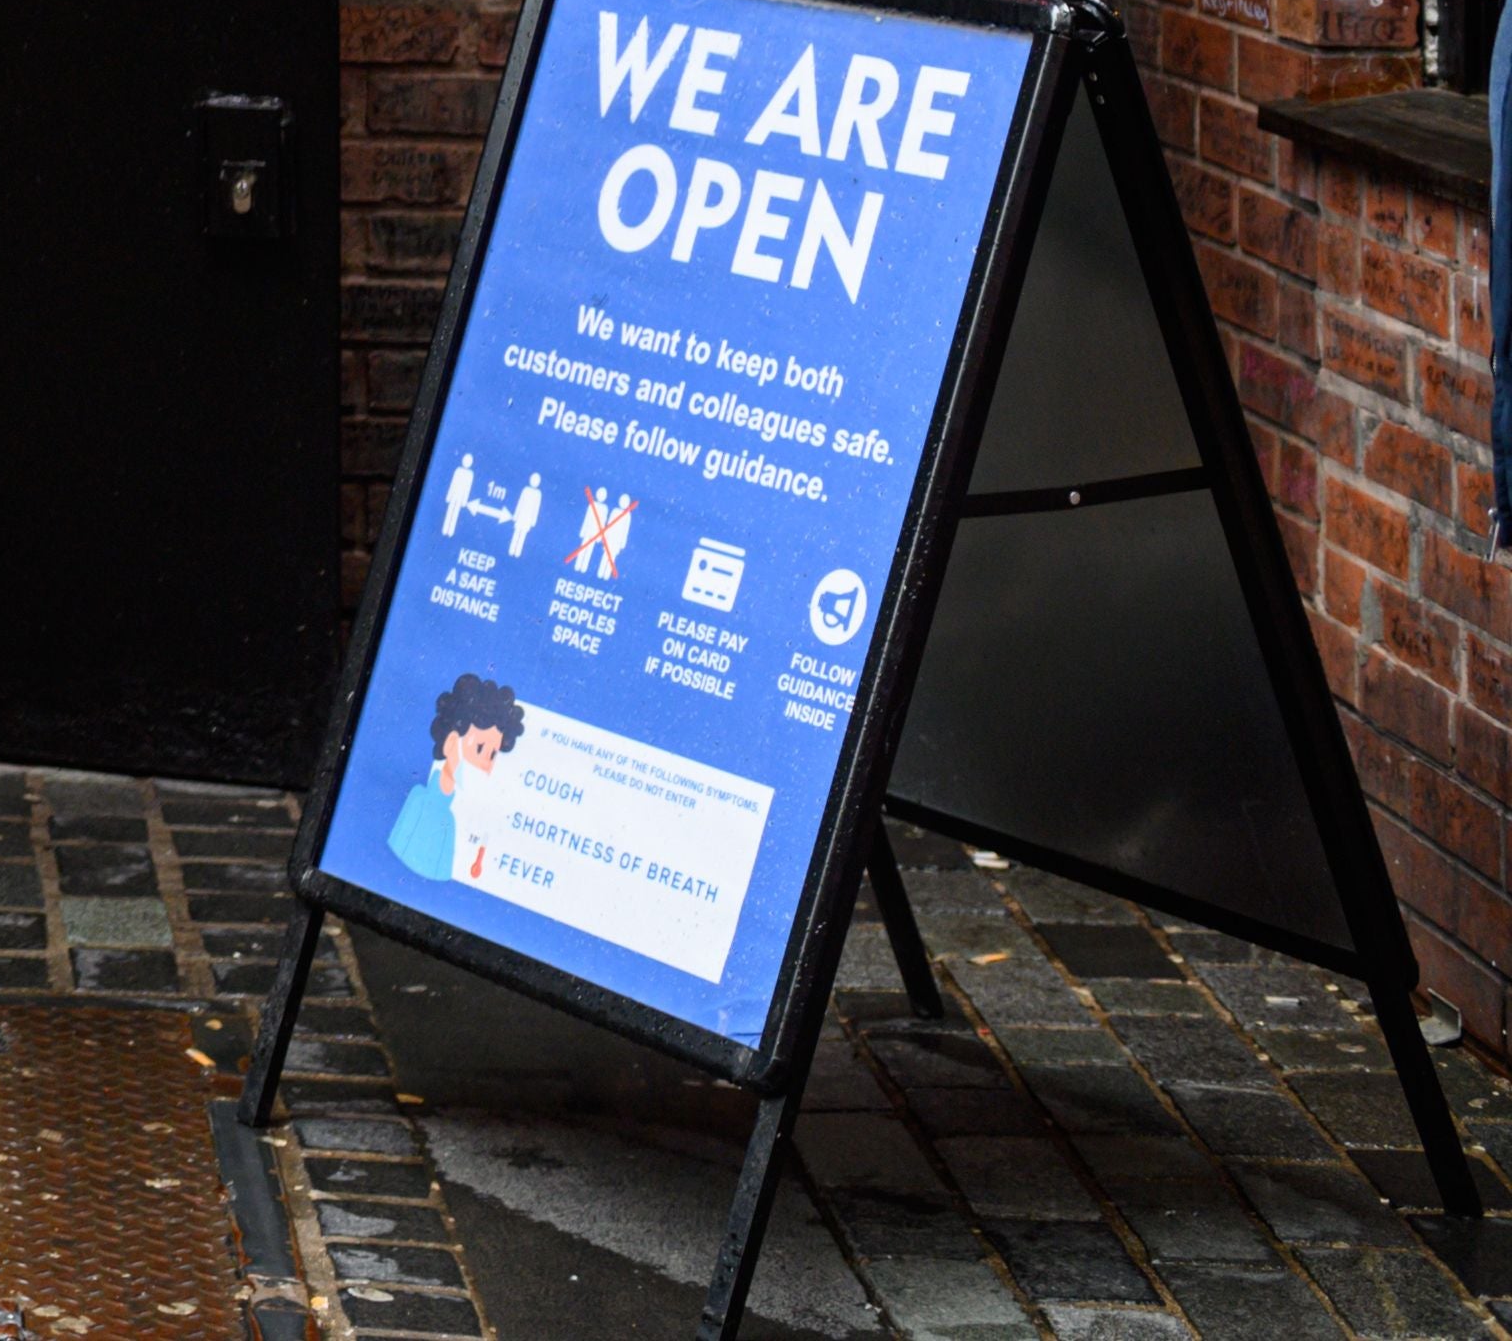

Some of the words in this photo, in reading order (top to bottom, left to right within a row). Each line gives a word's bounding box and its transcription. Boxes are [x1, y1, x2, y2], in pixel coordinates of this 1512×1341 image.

[598, 10, 742, 136] WE
[744, 42, 971, 181] ARE
[597, 143, 884, 305] OPEN
[576, 304, 614, 341] We
[620, 322, 681, 360] want
[685, 335, 711, 366] to
[716, 339, 779, 388] keep
[784, 355, 845, 398] both
[504, 343, 631, 396] customers
[636, 374, 685, 411] and
[688, 383, 827, 448] colleagues
[832, 427, 895, 467] safe.
[537, 396, 620, 445] Please
[623, 419, 701, 467] follow
[703, 447, 829, 503] guidance.
[457, 548, 496, 573] KEEP
[430, 585, 500, 623] DISTANCE
[554, 578, 623, 613] RESPECT
[548, 602, 617, 636] PEOPLES
[657, 613, 716, 644] PLEASE
[717, 628, 749, 655] PAY
[552, 625, 601, 655] SPACE
[662, 637, 685, 658] ON
[687, 645, 731, 673] CARD
[644, 657, 658, 675] IF
[660, 662, 736, 700] POSSIBLE
[790, 652, 855, 687] FOLLOW
[777, 675, 856, 713] GUIDANCE
[785, 701, 837, 731] INSIDE
[523, 770, 584, 805] COUGH
[498, 853, 555, 889] FEVER
[511, 812, 615, 864] SHORTNESS
[619, 852, 643, 873] OF
[647, 863, 719, 904] BREATH
